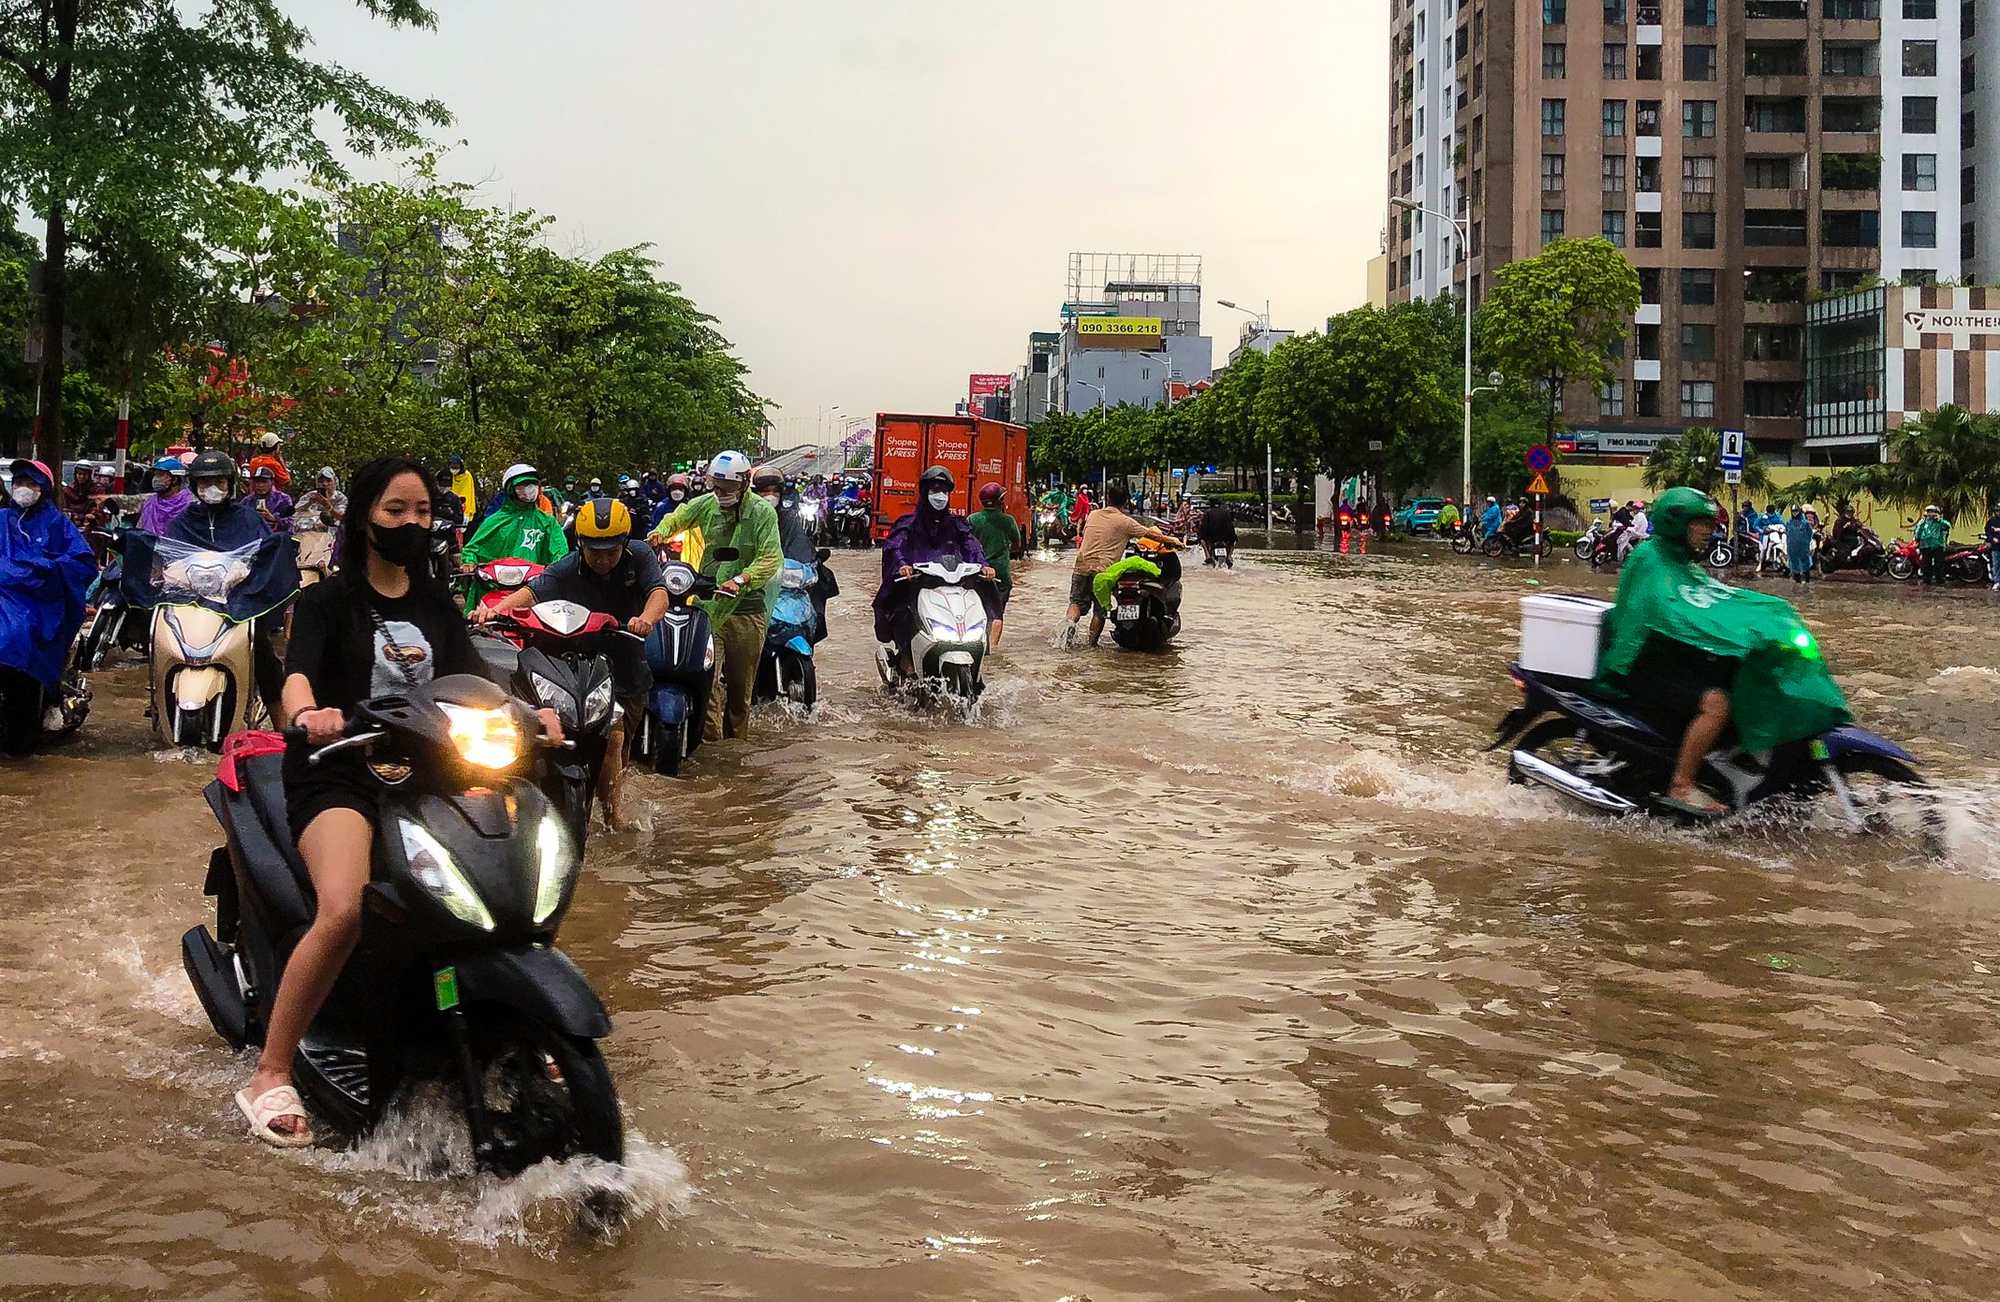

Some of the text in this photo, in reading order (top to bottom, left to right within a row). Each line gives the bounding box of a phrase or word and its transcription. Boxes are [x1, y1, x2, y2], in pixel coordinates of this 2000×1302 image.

[1082, 324, 1157, 333] 090 3366 218
[887, 436, 917, 447] Shopee
[937, 439, 968, 450] Shopee
[1626, 439, 1658, 447] MOBILIT
[885, 447, 917, 458] XPRESS
[935, 450, 968, 460] XPRESS
[893, 480, 915, 488] Shopee
